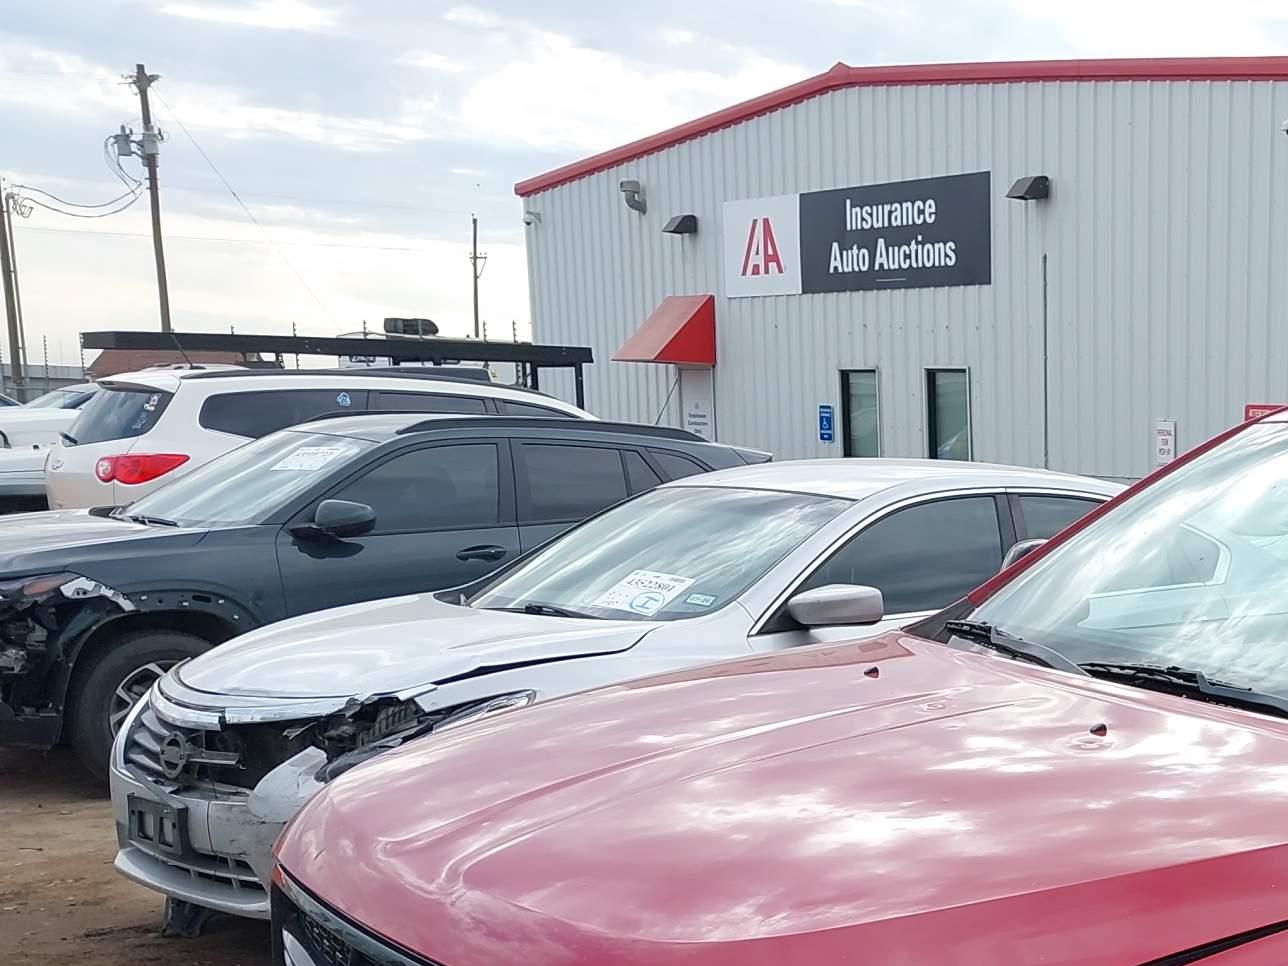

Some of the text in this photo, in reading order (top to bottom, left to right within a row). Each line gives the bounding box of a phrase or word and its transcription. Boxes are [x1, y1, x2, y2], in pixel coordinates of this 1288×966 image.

[845, 198, 937, 231] Insurance
[828, 235, 957, 273] Auto Auctions
